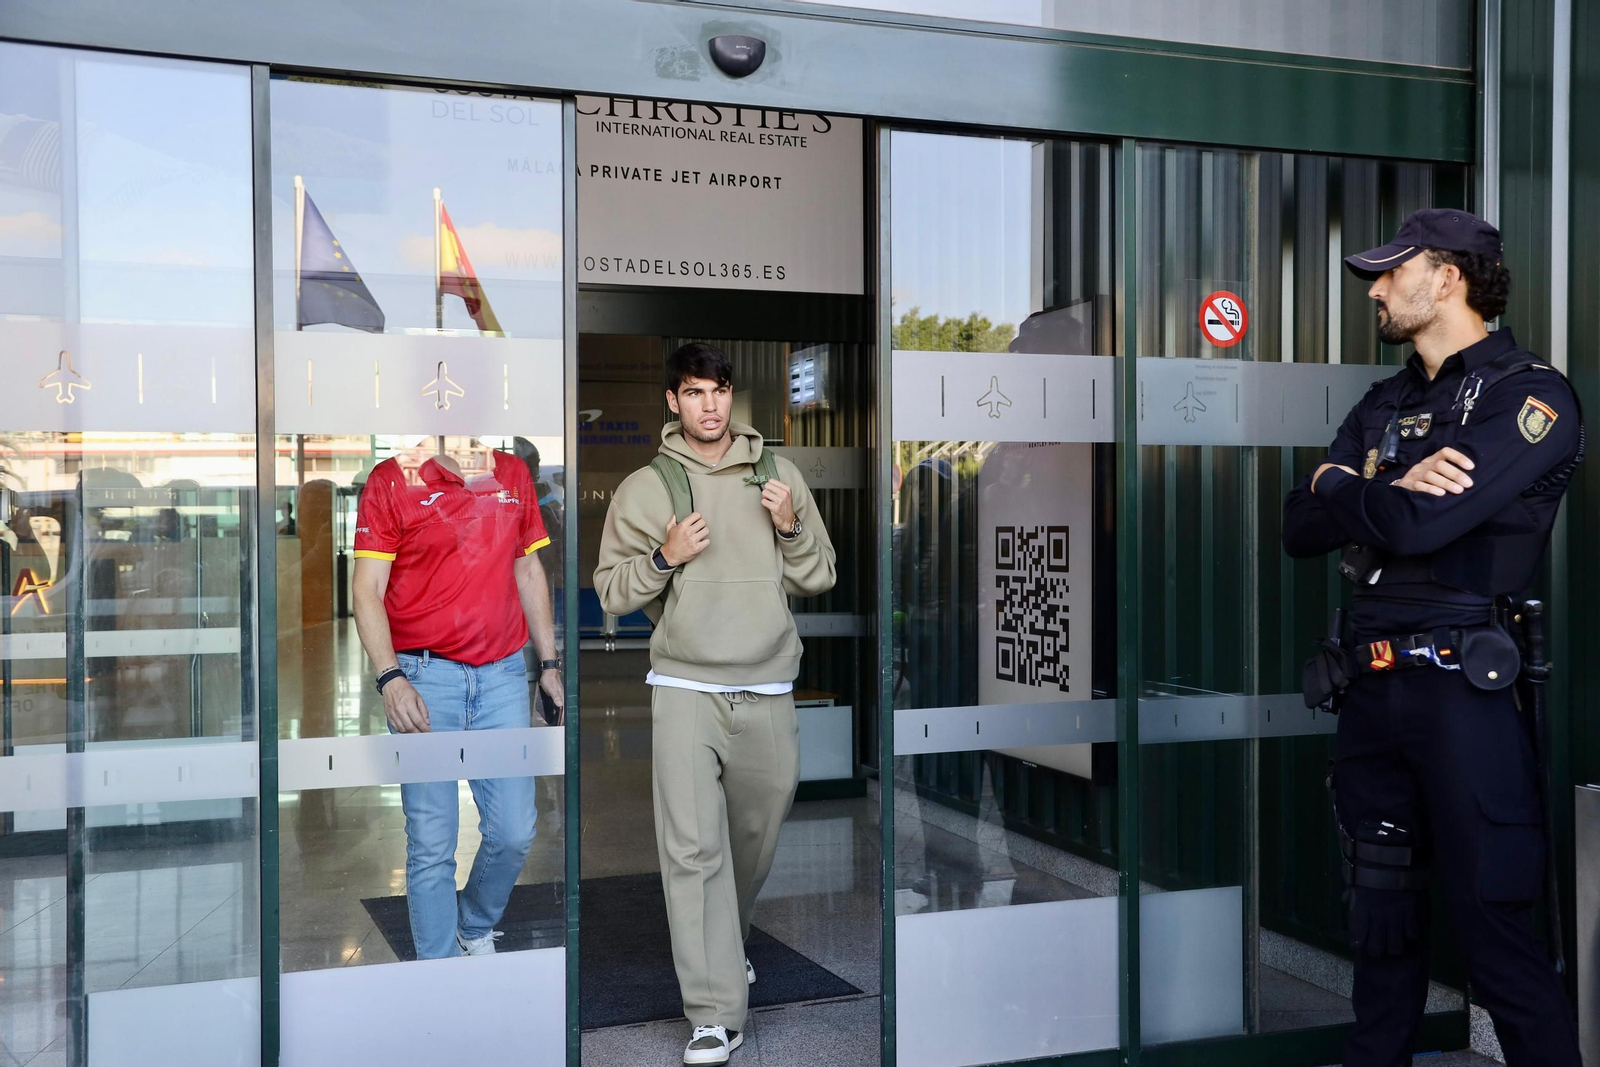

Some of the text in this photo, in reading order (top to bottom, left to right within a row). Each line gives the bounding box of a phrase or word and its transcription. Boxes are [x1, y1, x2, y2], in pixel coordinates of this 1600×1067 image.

[432, 100, 540, 126] DEL SOL
[596, 121, 807, 148] INTERNATIONAL REAL ESTATE
[590, 164, 662, 182] PRIVATE
[671, 170, 701, 184] JET
[709, 173, 782, 190] AIRPORT
[600, 421, 639, 432] TAXIS
